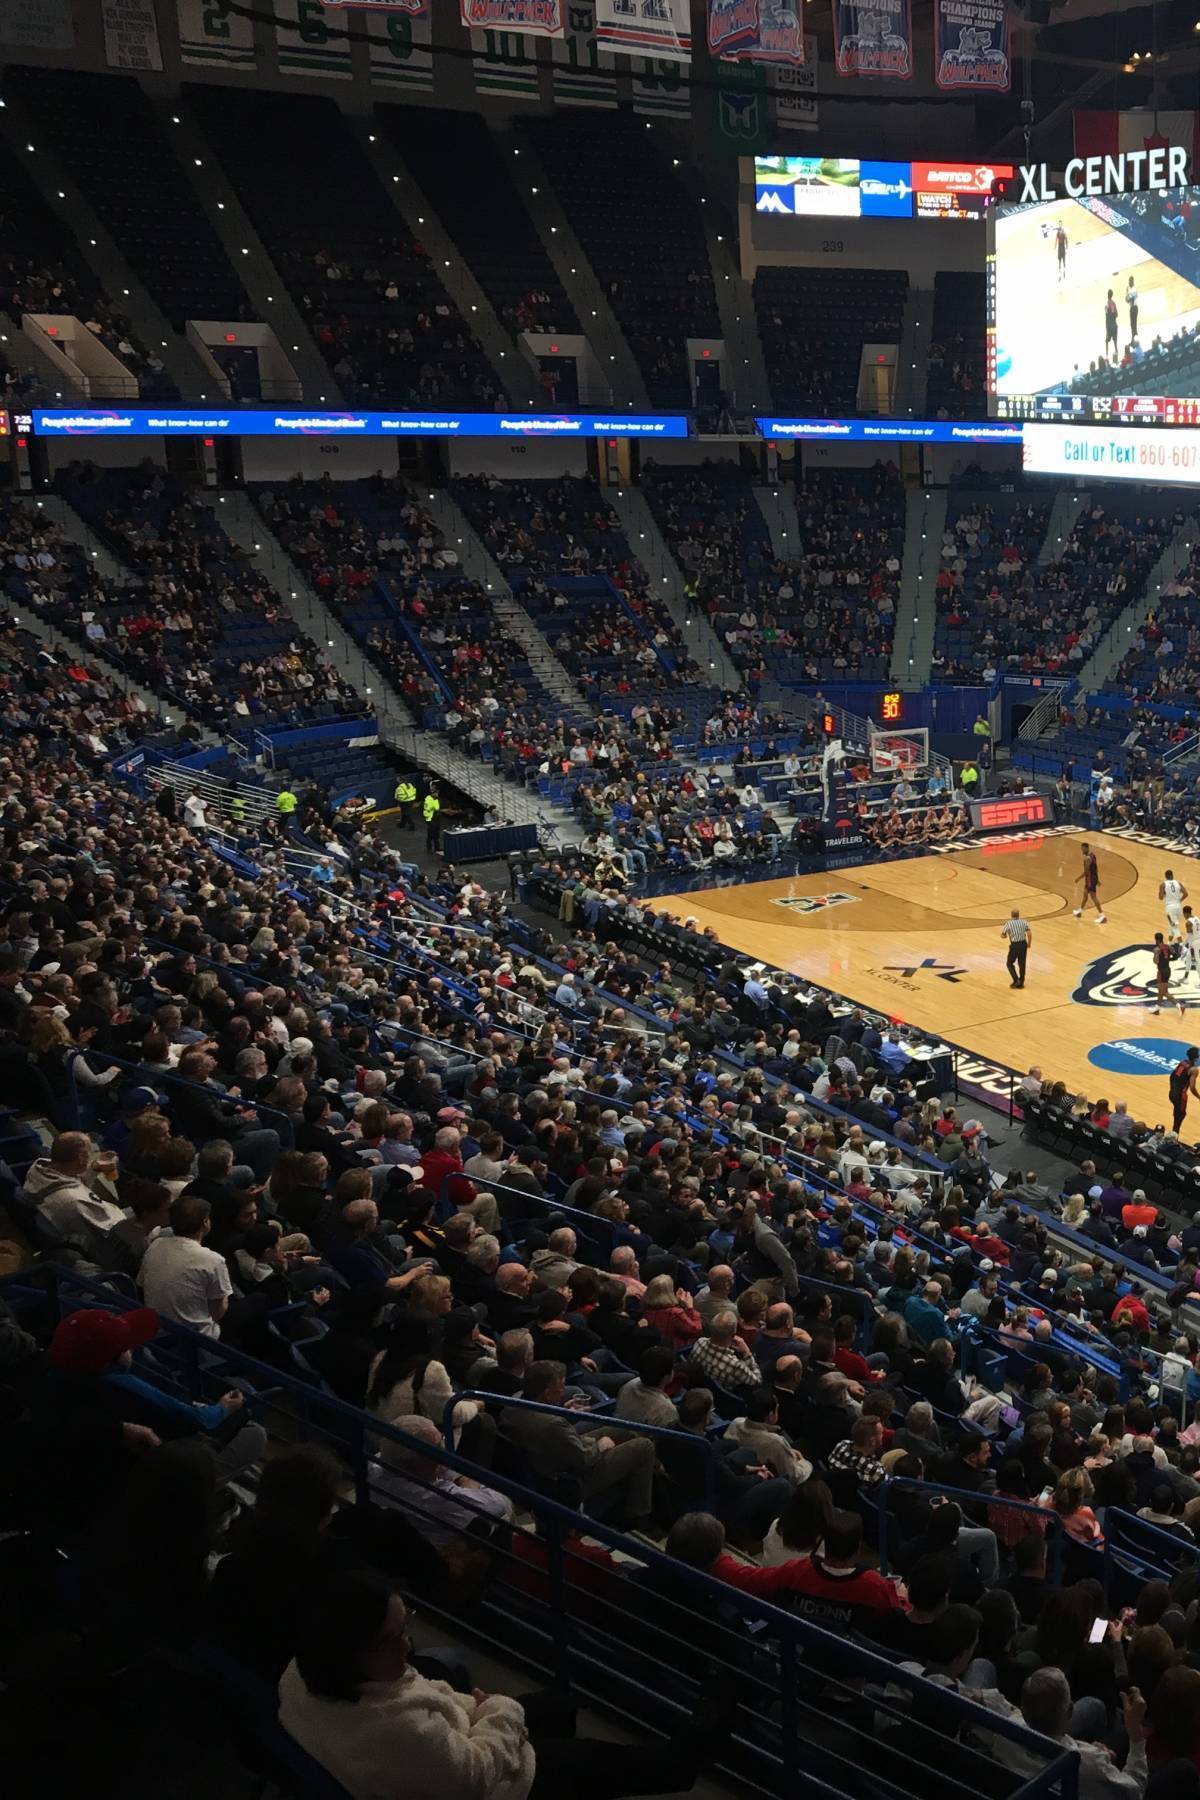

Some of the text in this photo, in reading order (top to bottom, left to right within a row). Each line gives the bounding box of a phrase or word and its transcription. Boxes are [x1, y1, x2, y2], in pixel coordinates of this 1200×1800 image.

[940, 1, 1003, 22] CHAMPIONS
[1018, 146, 1189, 202] XL CENTER
[921, 195, 951, 203] WATCH
[822, 240, 844, 253] 239
[1093, 398, 1111, 411] 8:52
[1118, 399, 1127, 411] 17
[13, 415, 32, 424] 7:25
[148, 419, 167, 427] What
[511, 445, 527, 454] 110
[1064, 439, 1089, 462] Call
[1092, 444, 1104, 462] or
[1109, 442, 1135, 464] Text
[883, 703, 898, 718] 30
[980, 799, 1044, 828] ESPN
[825, 836, 863, 848] TRAVELERS
[929, 824, 1087, 854] HUSKIES
[878, 972, 921, 991] CENTER
[793, 1595, 853, 1623] UCONN
